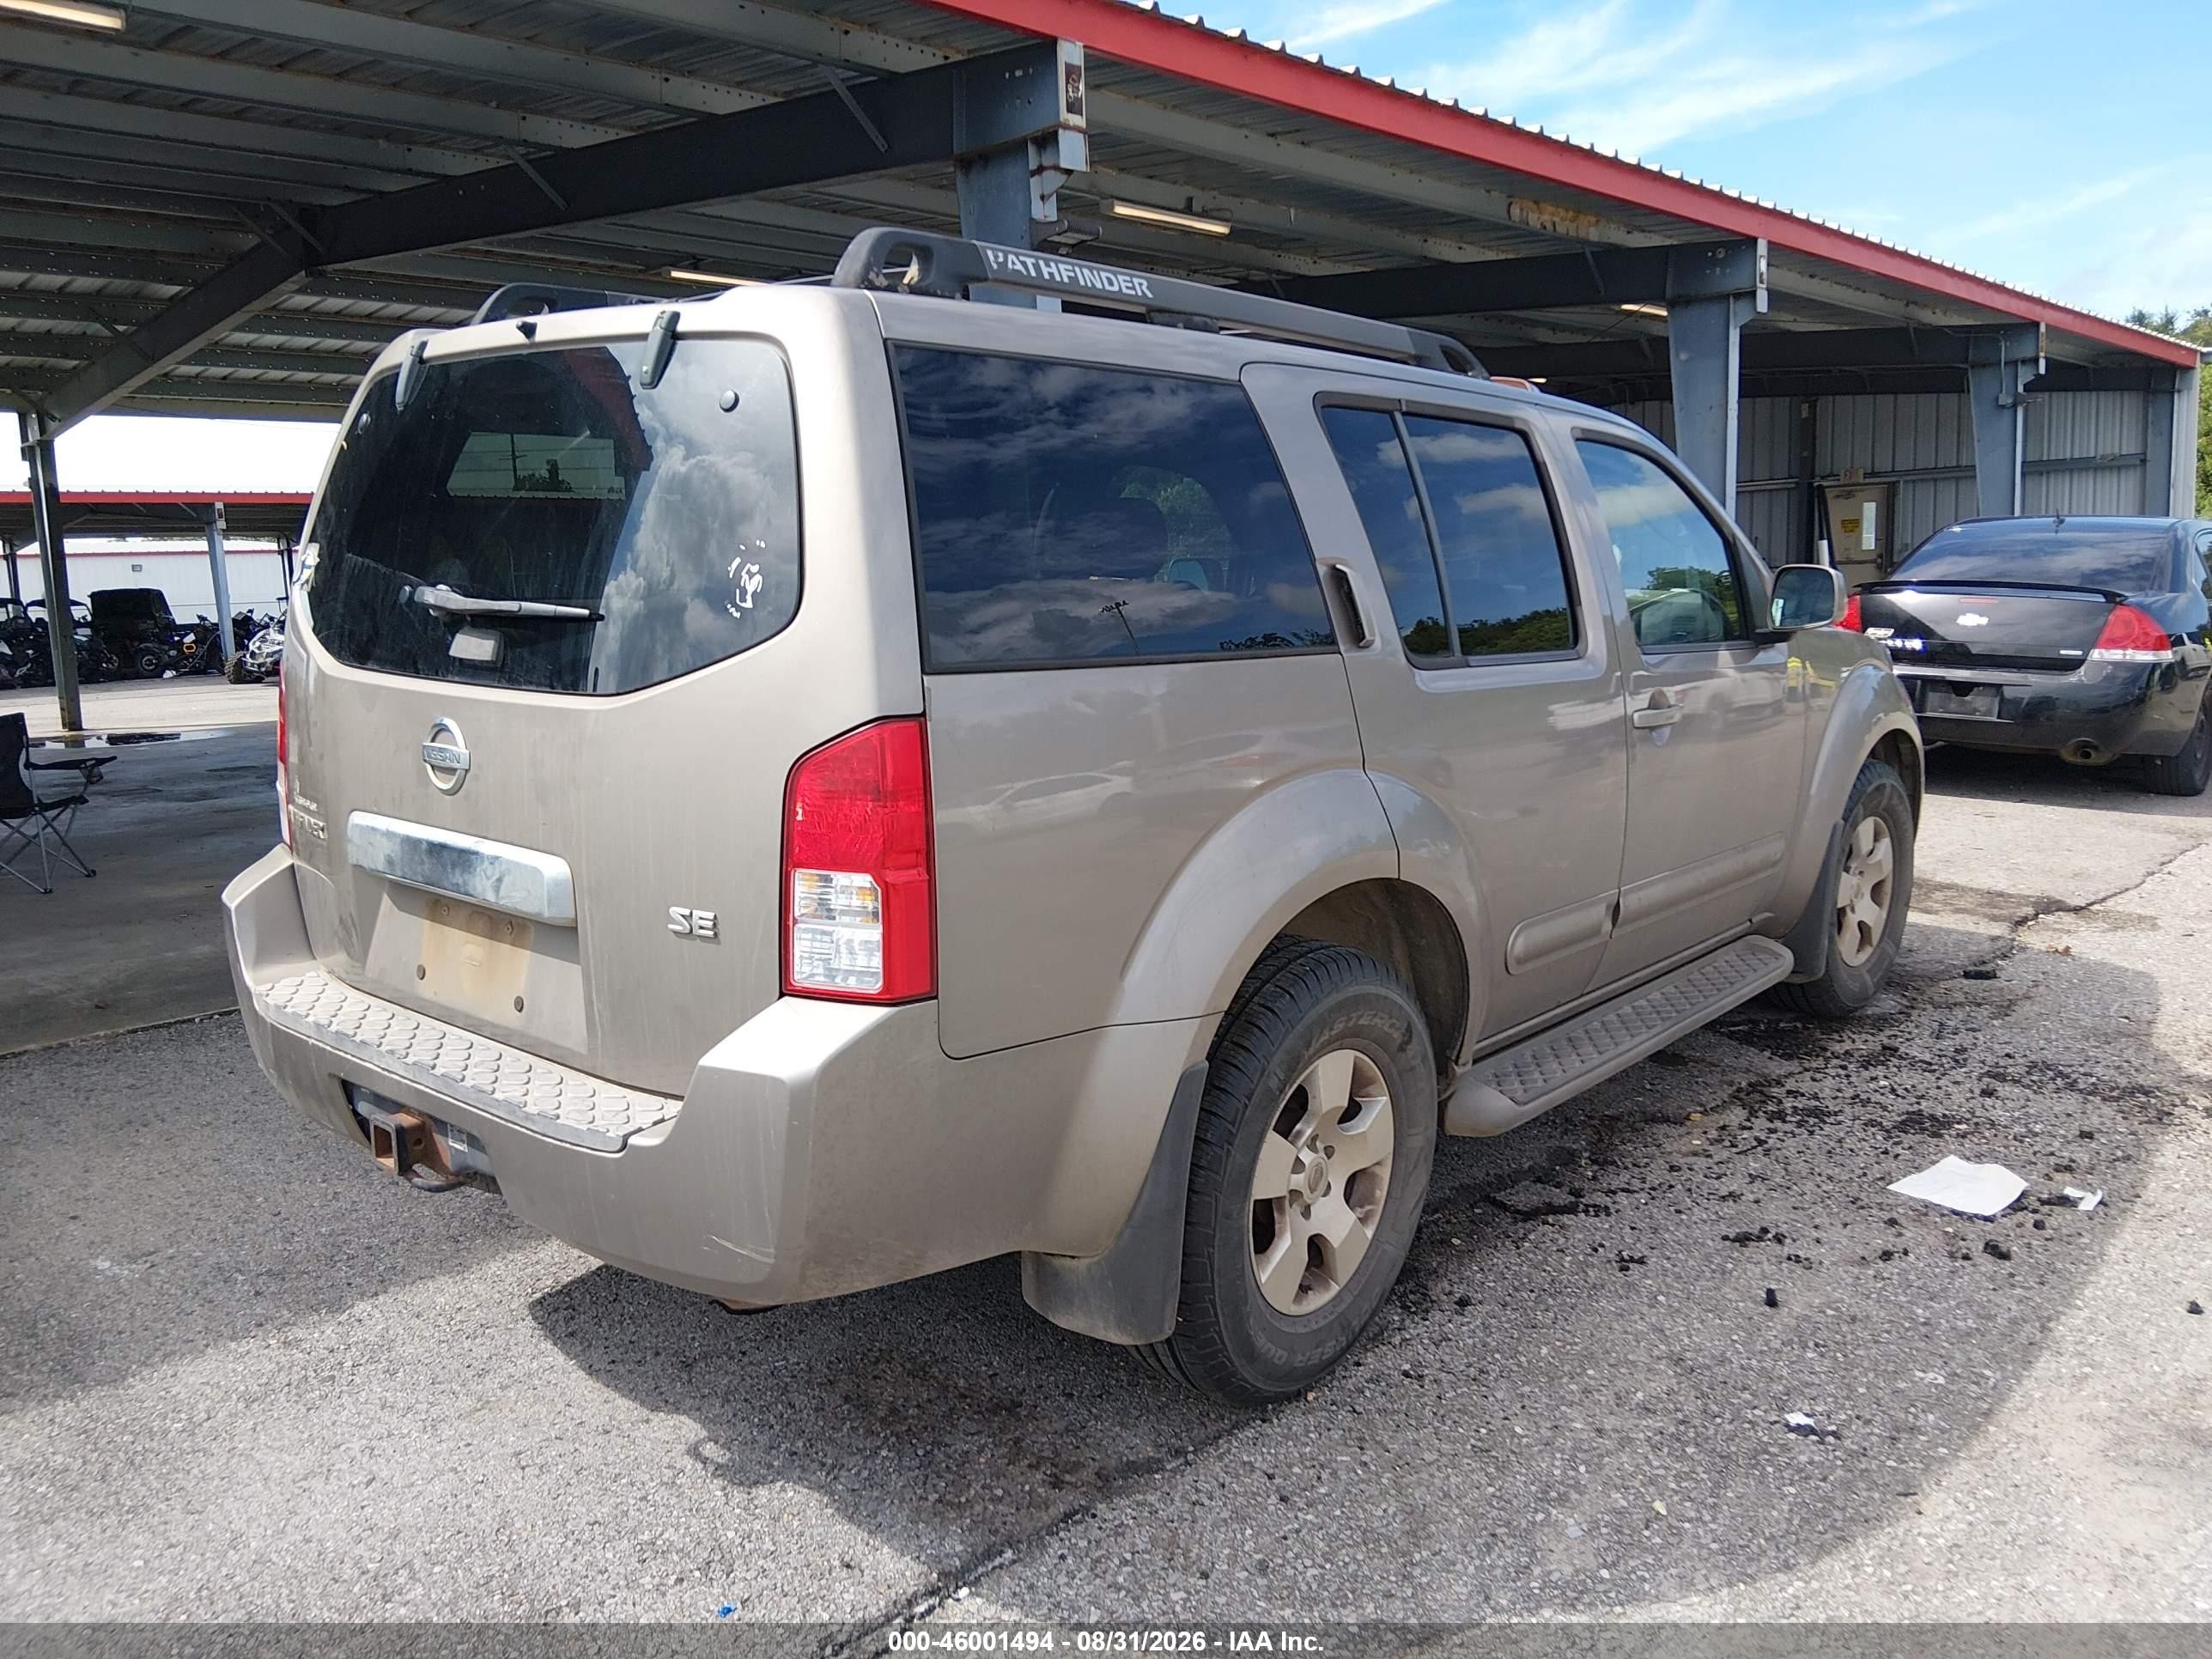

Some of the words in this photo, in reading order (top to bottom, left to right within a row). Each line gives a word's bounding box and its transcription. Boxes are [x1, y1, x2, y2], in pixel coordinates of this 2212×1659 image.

[986, 248, 1154, 299] PATHFINDER
[423, 744, 464, 766] NISSAN
[667, 906, 718, 939] SE
